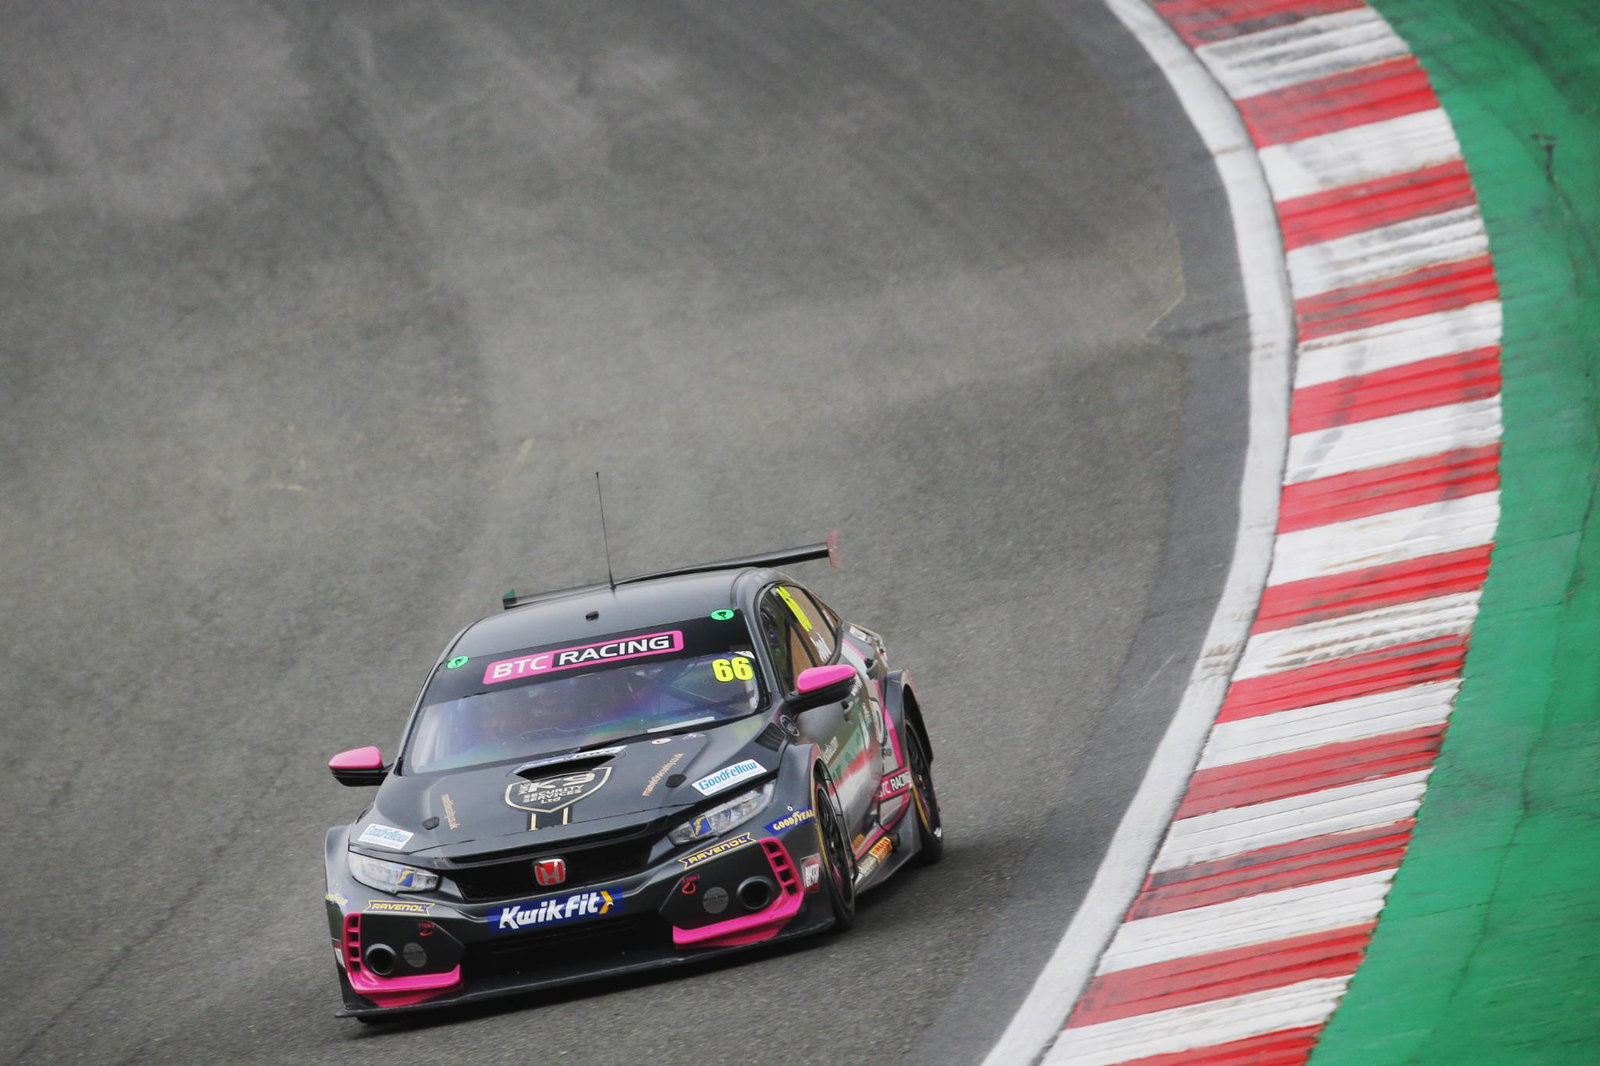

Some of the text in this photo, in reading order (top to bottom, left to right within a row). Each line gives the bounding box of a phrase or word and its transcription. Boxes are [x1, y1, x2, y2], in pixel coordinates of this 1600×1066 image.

[491, 635, 671, 680] BTC RACING
[712, 656, 754, 682] 66
[687, 836, 747, 864] RAVENOL
[370, 902, 426, 913] RAVENOL
